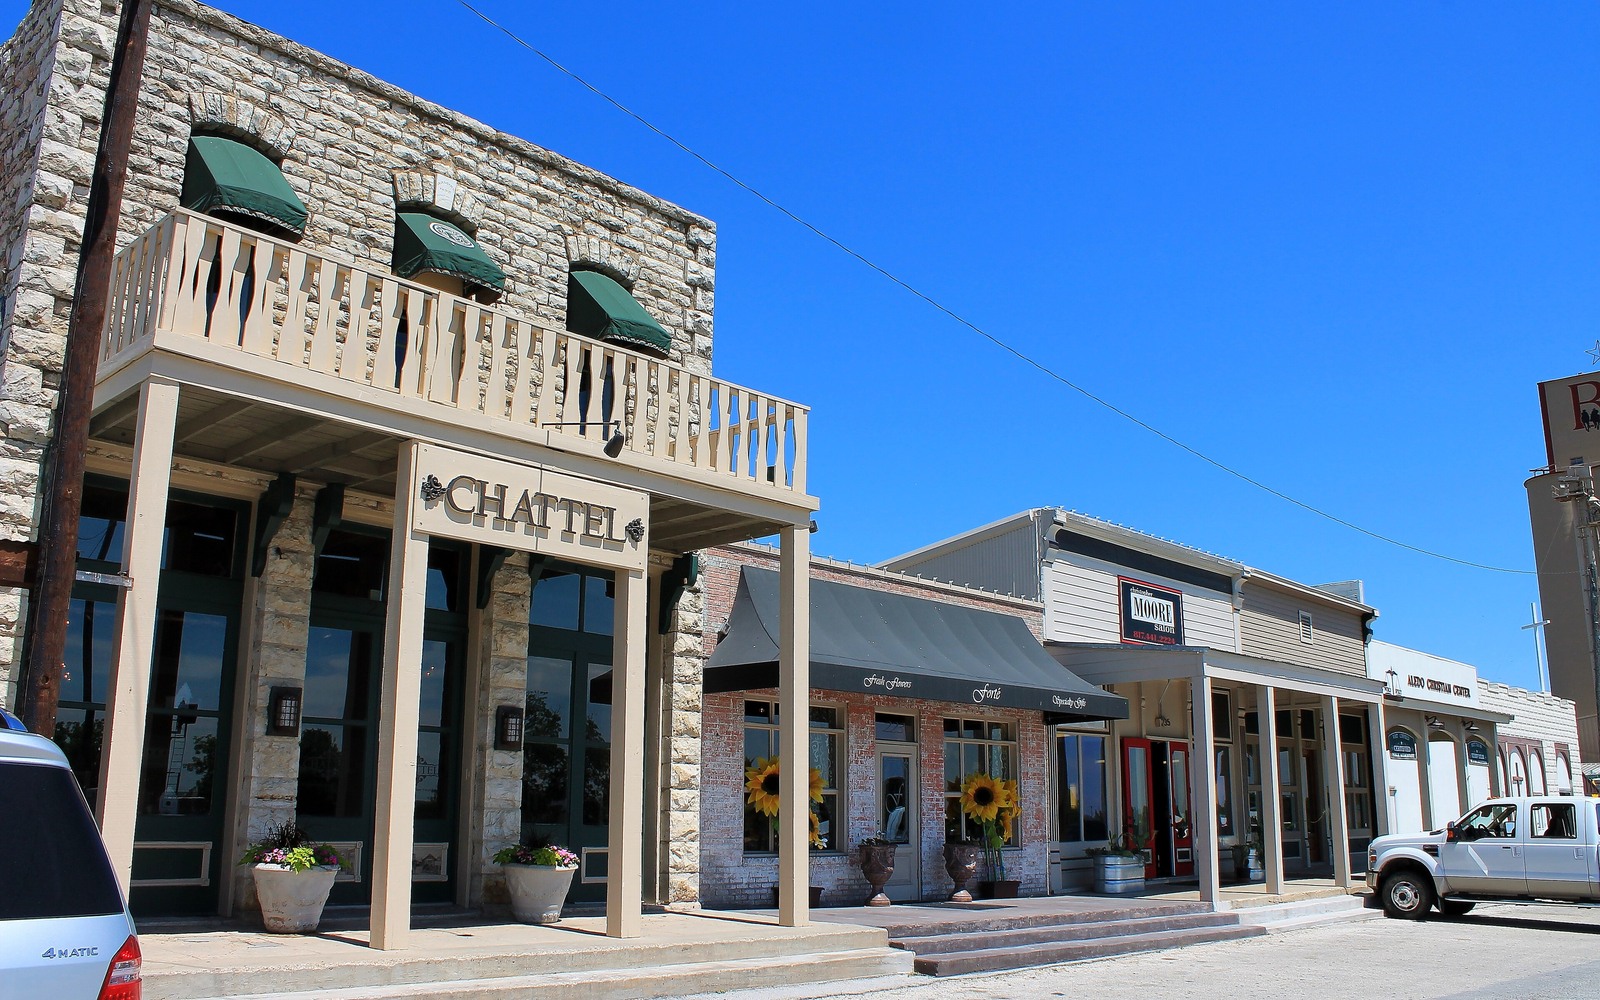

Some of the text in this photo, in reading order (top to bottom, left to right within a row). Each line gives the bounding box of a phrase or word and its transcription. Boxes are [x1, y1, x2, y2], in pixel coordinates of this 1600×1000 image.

[445, 475, 627, 545] CHATTEL
[1133, 596, 1172, 624] MOORE
[1154, 623, 1175, 634] salon
[863, 673, 912, 690] Fresh Flowers
[1407, 675, 1471, 698] ALEDO CHRISTIAN CENTER
[972, 683, 1001, 703] Forté
[41, 947, 99, 959] 4MATIC
